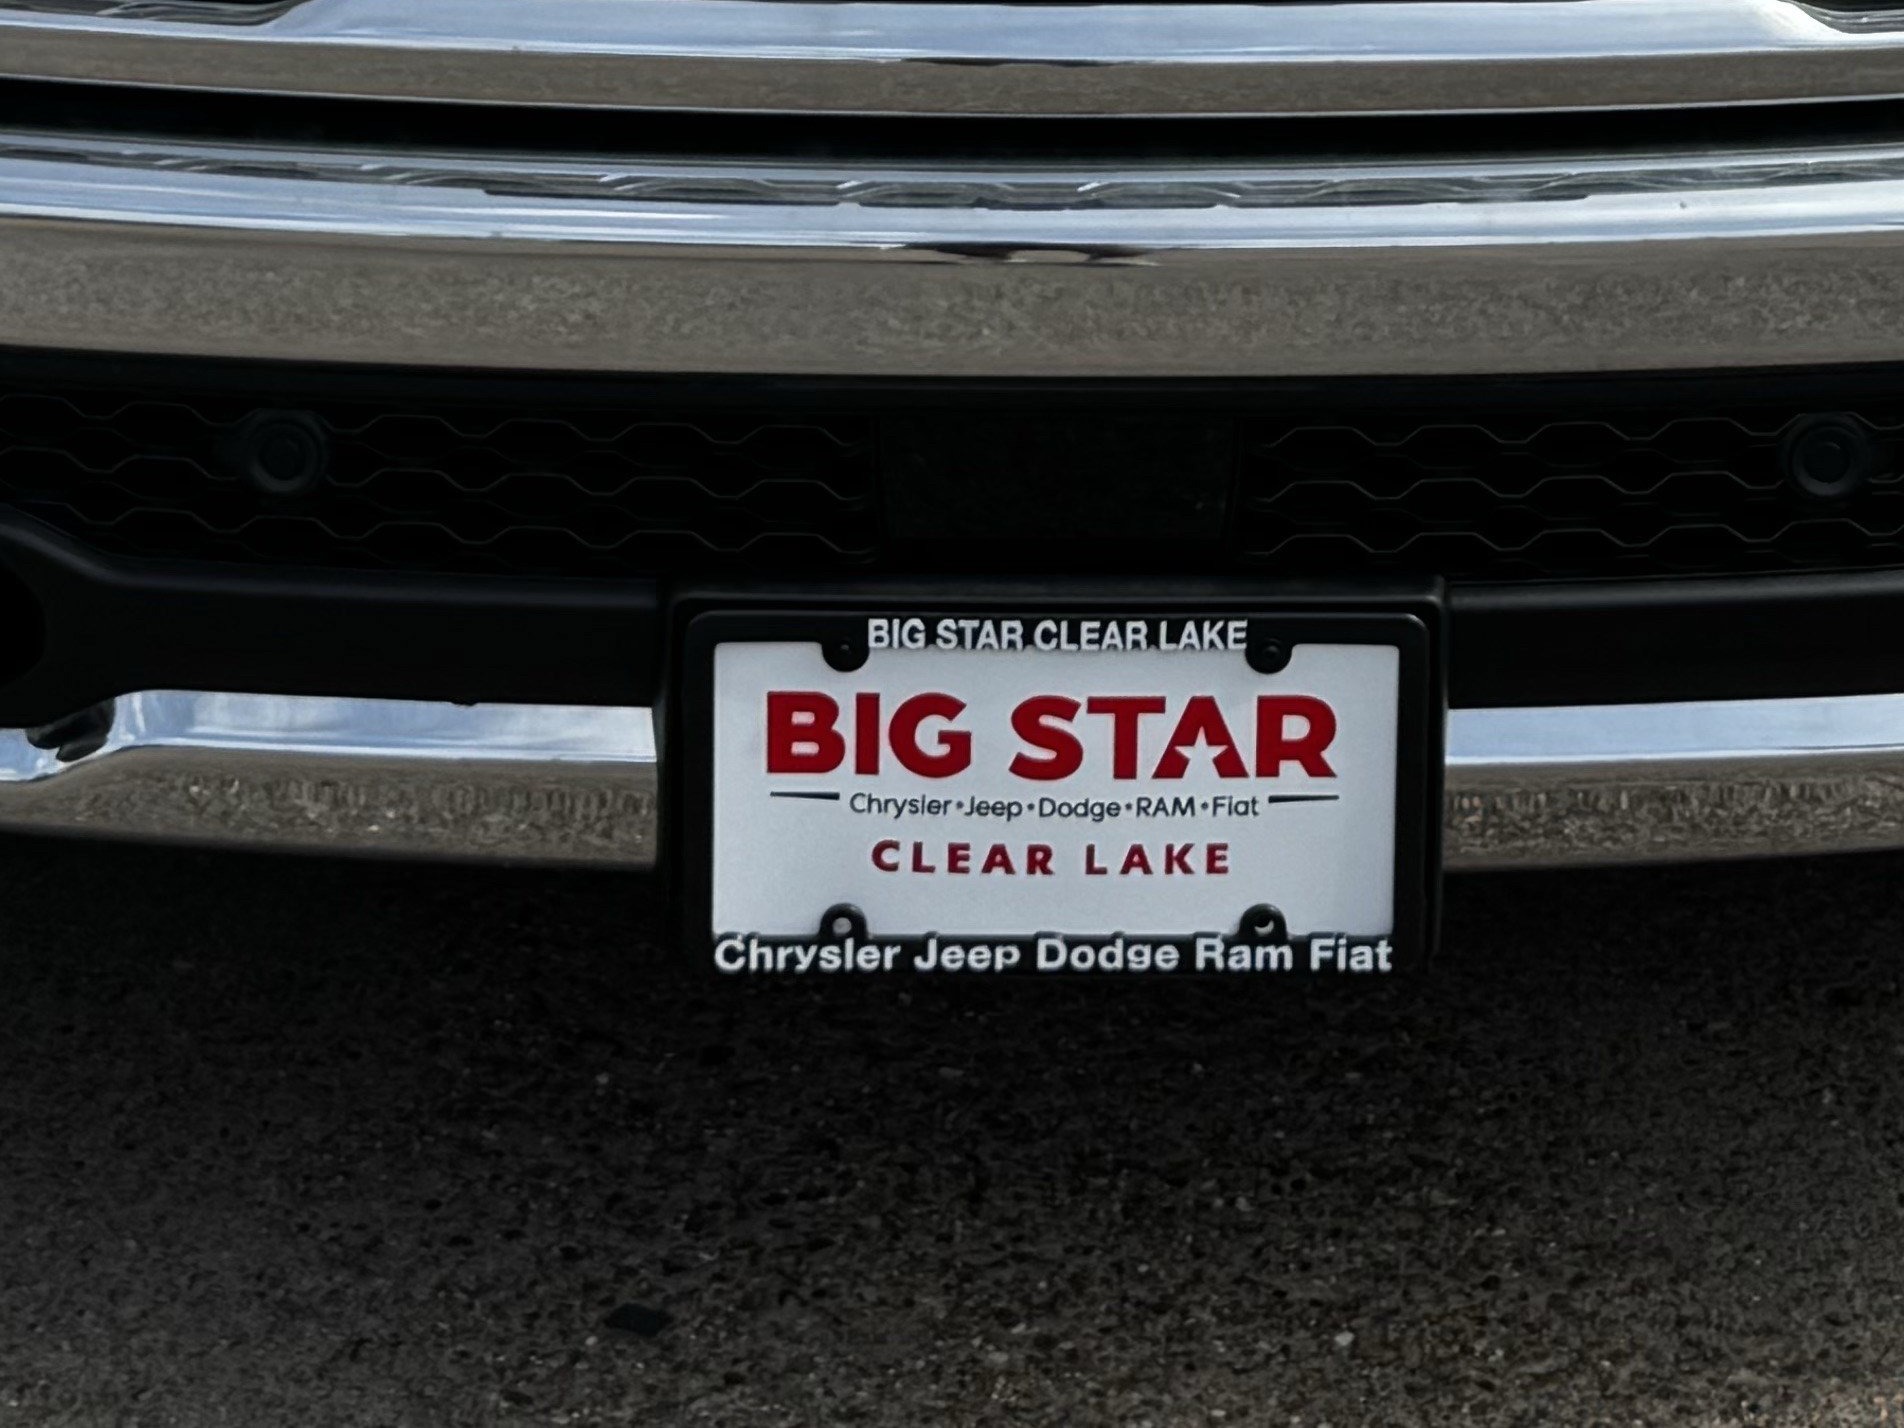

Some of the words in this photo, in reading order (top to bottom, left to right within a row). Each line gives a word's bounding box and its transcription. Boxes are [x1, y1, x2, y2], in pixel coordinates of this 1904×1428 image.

[867, 618, 926, 650] BIG
[935, 619, 1024, 651] STAR
[1033, 619, 1148, 651] CLEAR
[1159, 619, 1247, 651] LAKE
[766, 691, 972, 778] BIG
[1009, 694, 1339, 781] STAR
[871, 839, 1056, 876] CLEAR
[1084, 842, 1231, 876] LAKE
[714, 936, 901, 973] Chrysler
[914, 936, 1022, 973] Jeep
[1036, 936, 1181, 973] Dodge
[1195, 936, 1294, 972] Ram
[1309, 936, 1394, 972] Fiat
